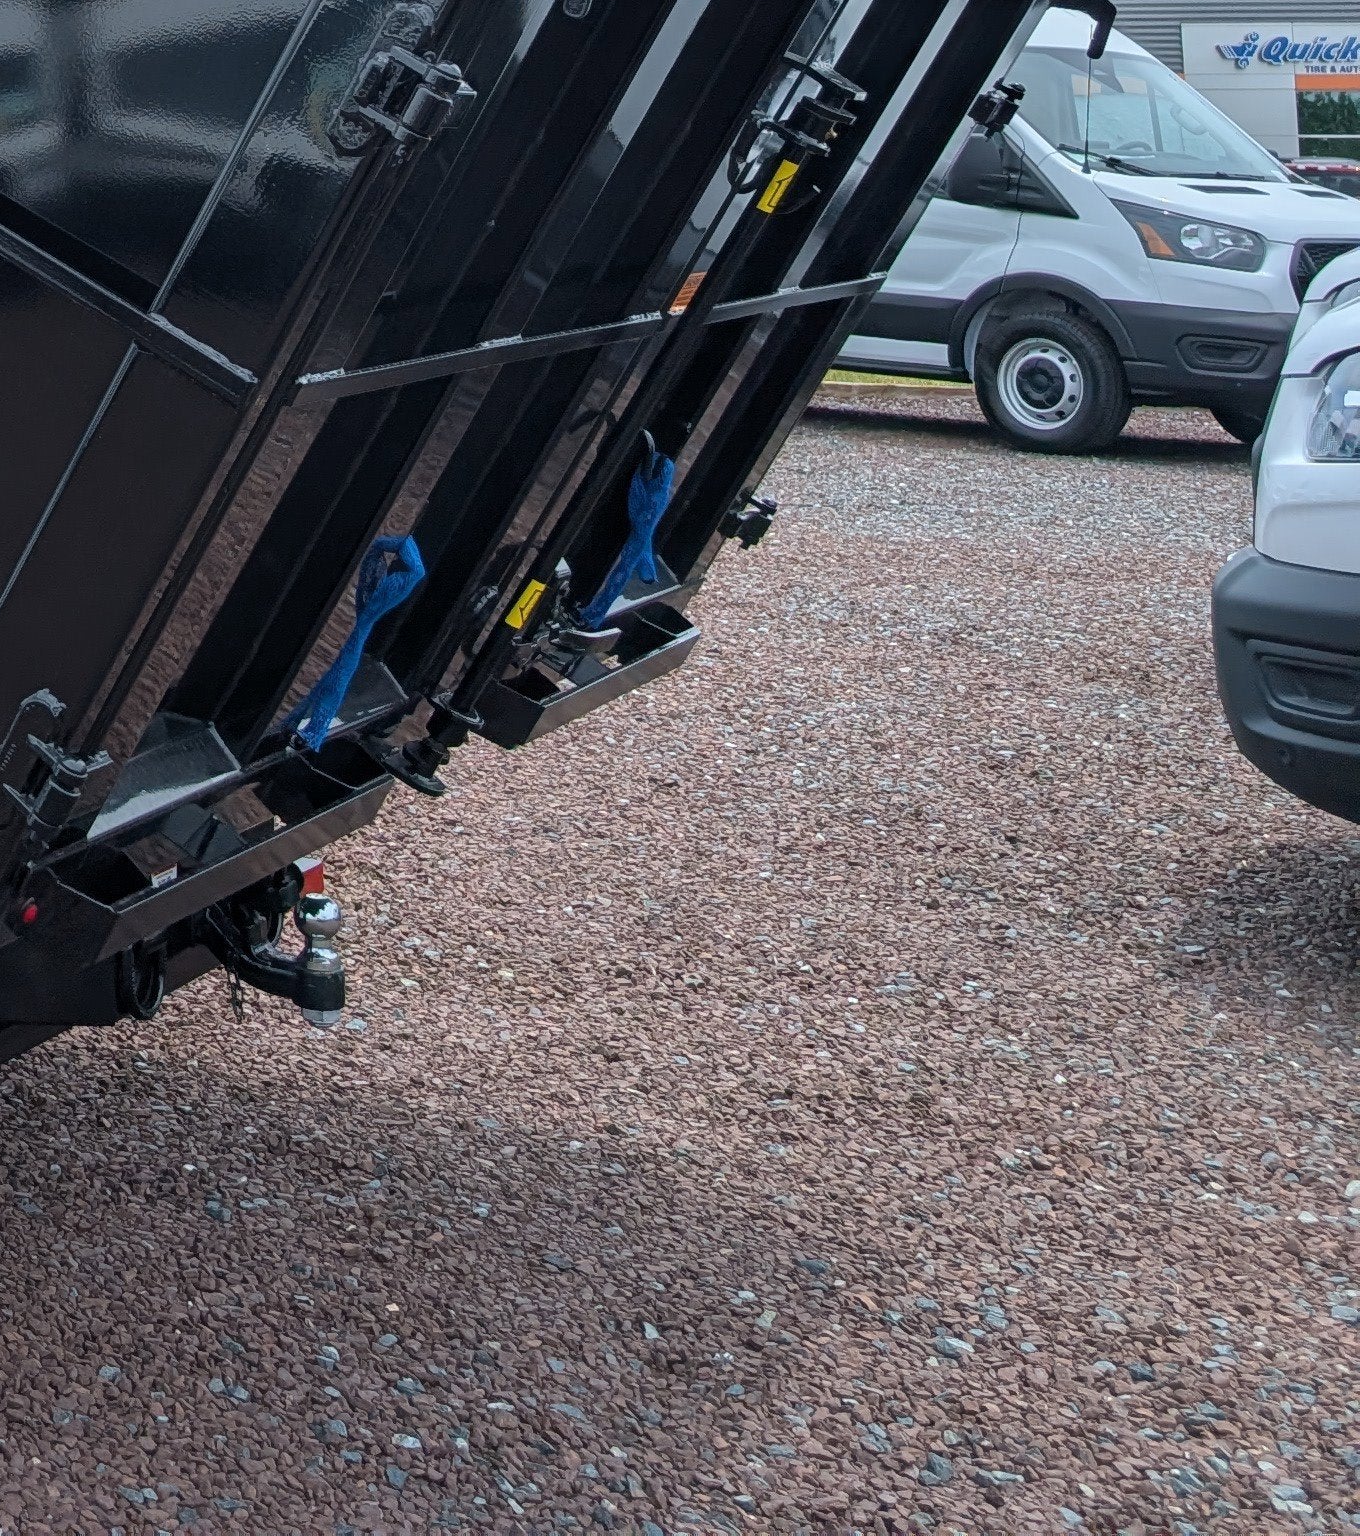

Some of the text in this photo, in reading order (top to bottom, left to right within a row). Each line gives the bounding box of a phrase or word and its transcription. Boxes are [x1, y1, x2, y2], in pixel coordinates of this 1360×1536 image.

[1263, 36, 1360, 64] Quick
[1305, 65, 1327, 73] TIRE
[1340, 65, 1360, 73] AUT
